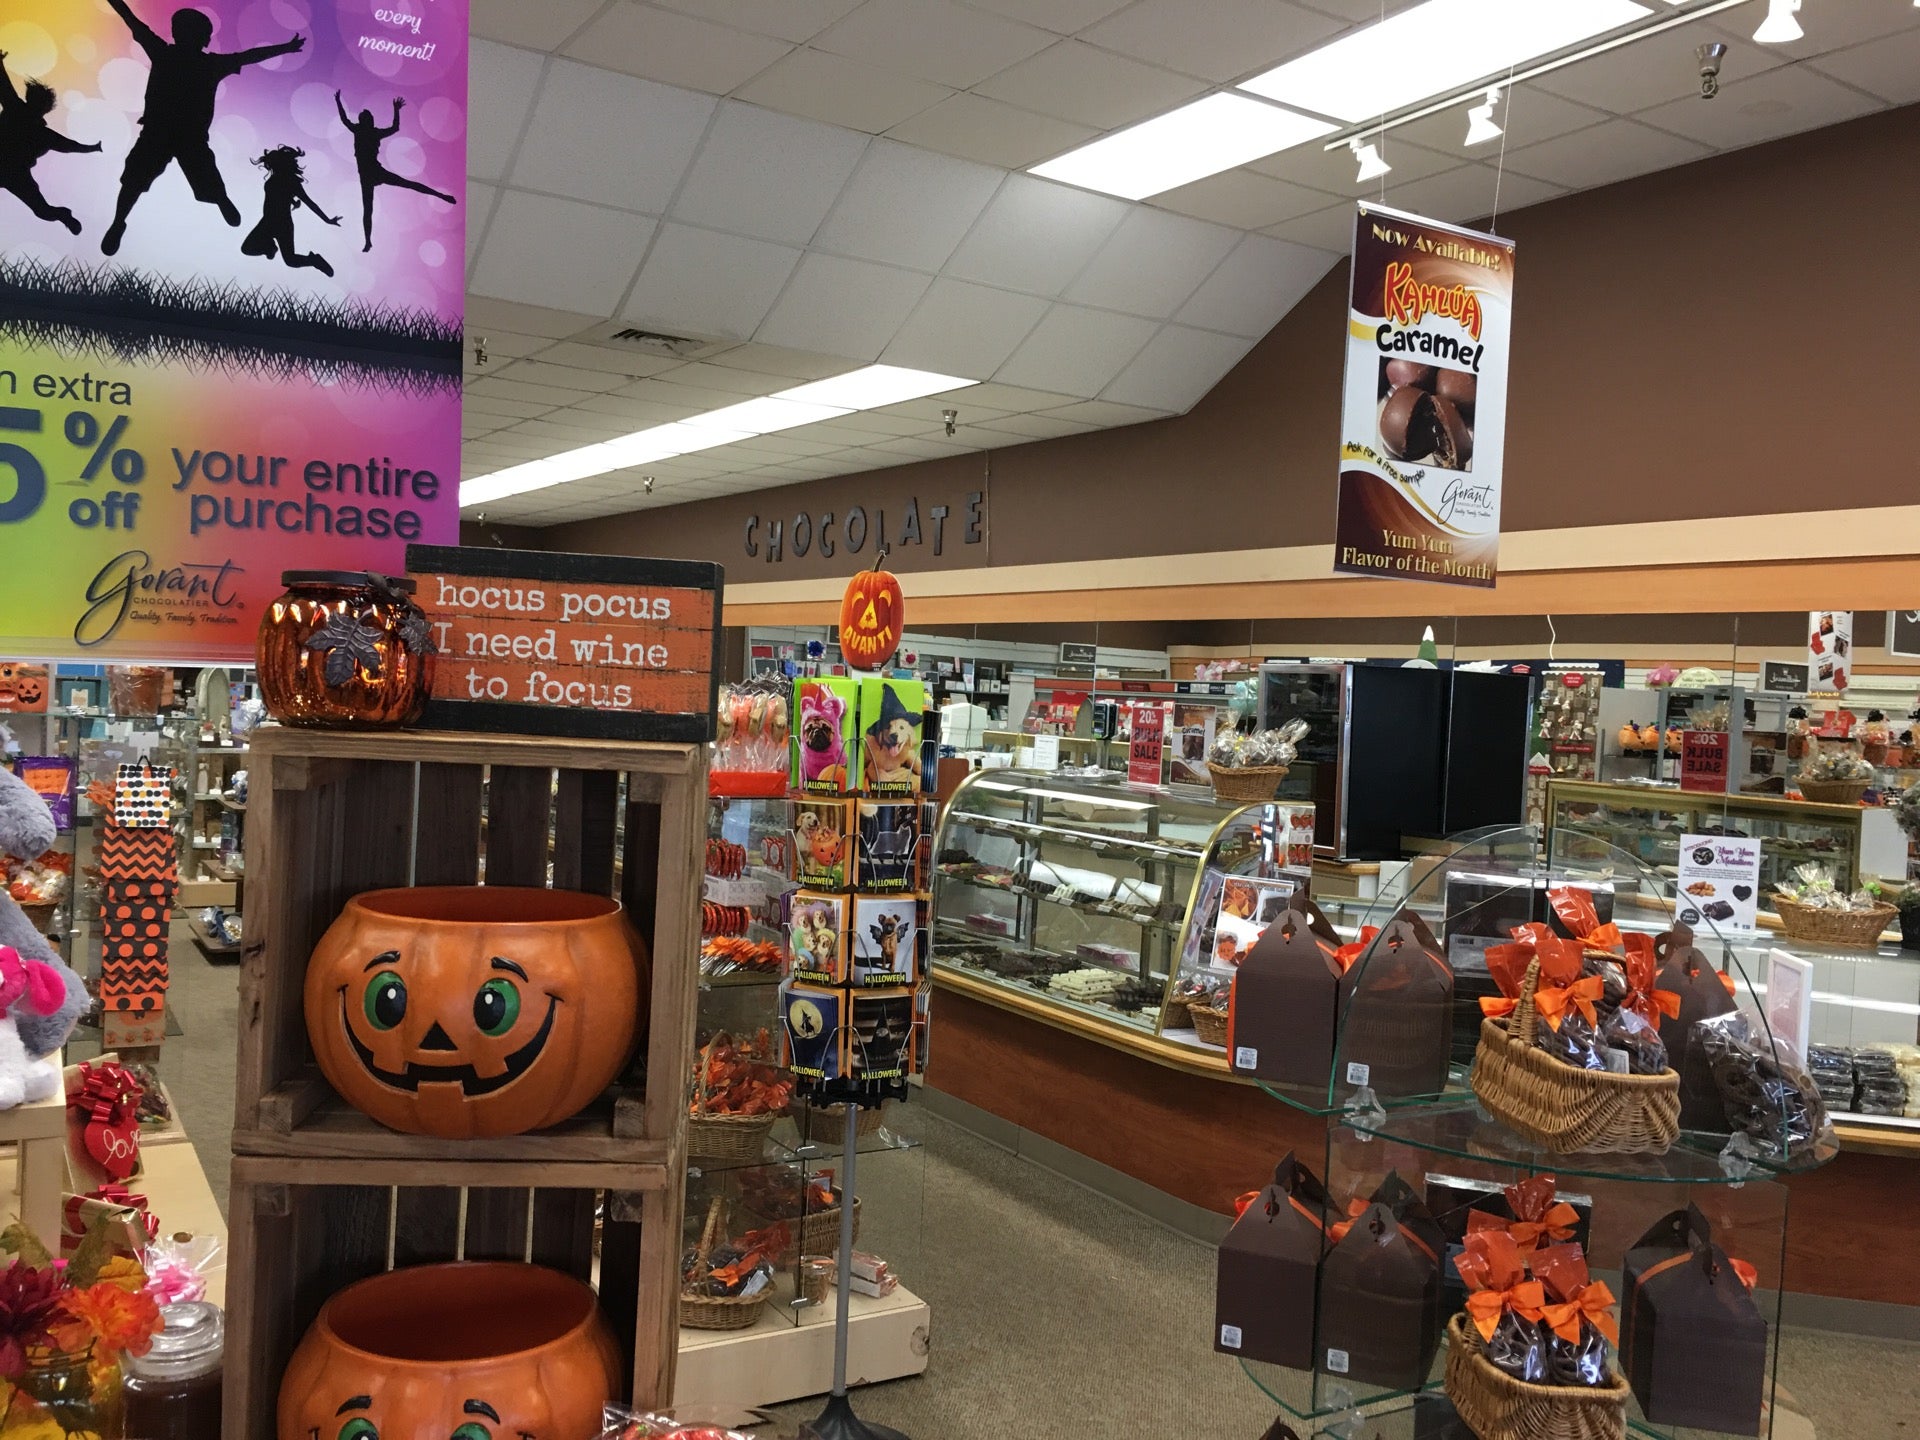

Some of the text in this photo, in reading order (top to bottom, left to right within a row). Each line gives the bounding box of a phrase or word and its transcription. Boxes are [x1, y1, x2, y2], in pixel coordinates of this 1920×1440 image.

[374, 9, 421, 34] every
[358, 35, 436, 61] moment!
[1372, 223, 1501, 271] Now Available!
[1376, 324, 1484, 373] Caramel
[33, 372, 131, 405] extra
[1347, 441, 1362, 453] Ask
[171, 447, 439, 501] your entire
[68, 490, 141, 529] off
[190, 493, 423, 540] purchase
[744, 491, 982, 563] CHOCOLATE
[1382, 529, 1453, 555] Yum Yum
[1342, 547, 1492, 581] Flavor of the Month
[133, 597, 209, 607] CHOCOLATIER
[436, 577, 671, 622] hocus pocus
[434, 622, 668, 668] I need wine
[843, 624, 893, 656] AVANTI
[465, 667, 633, 707] to focus
[1134, 727, 1161, 743] BULK
[1134, 744, 1158, 760] SALE
[1715, 846, 1754, 858] Yum Yum
